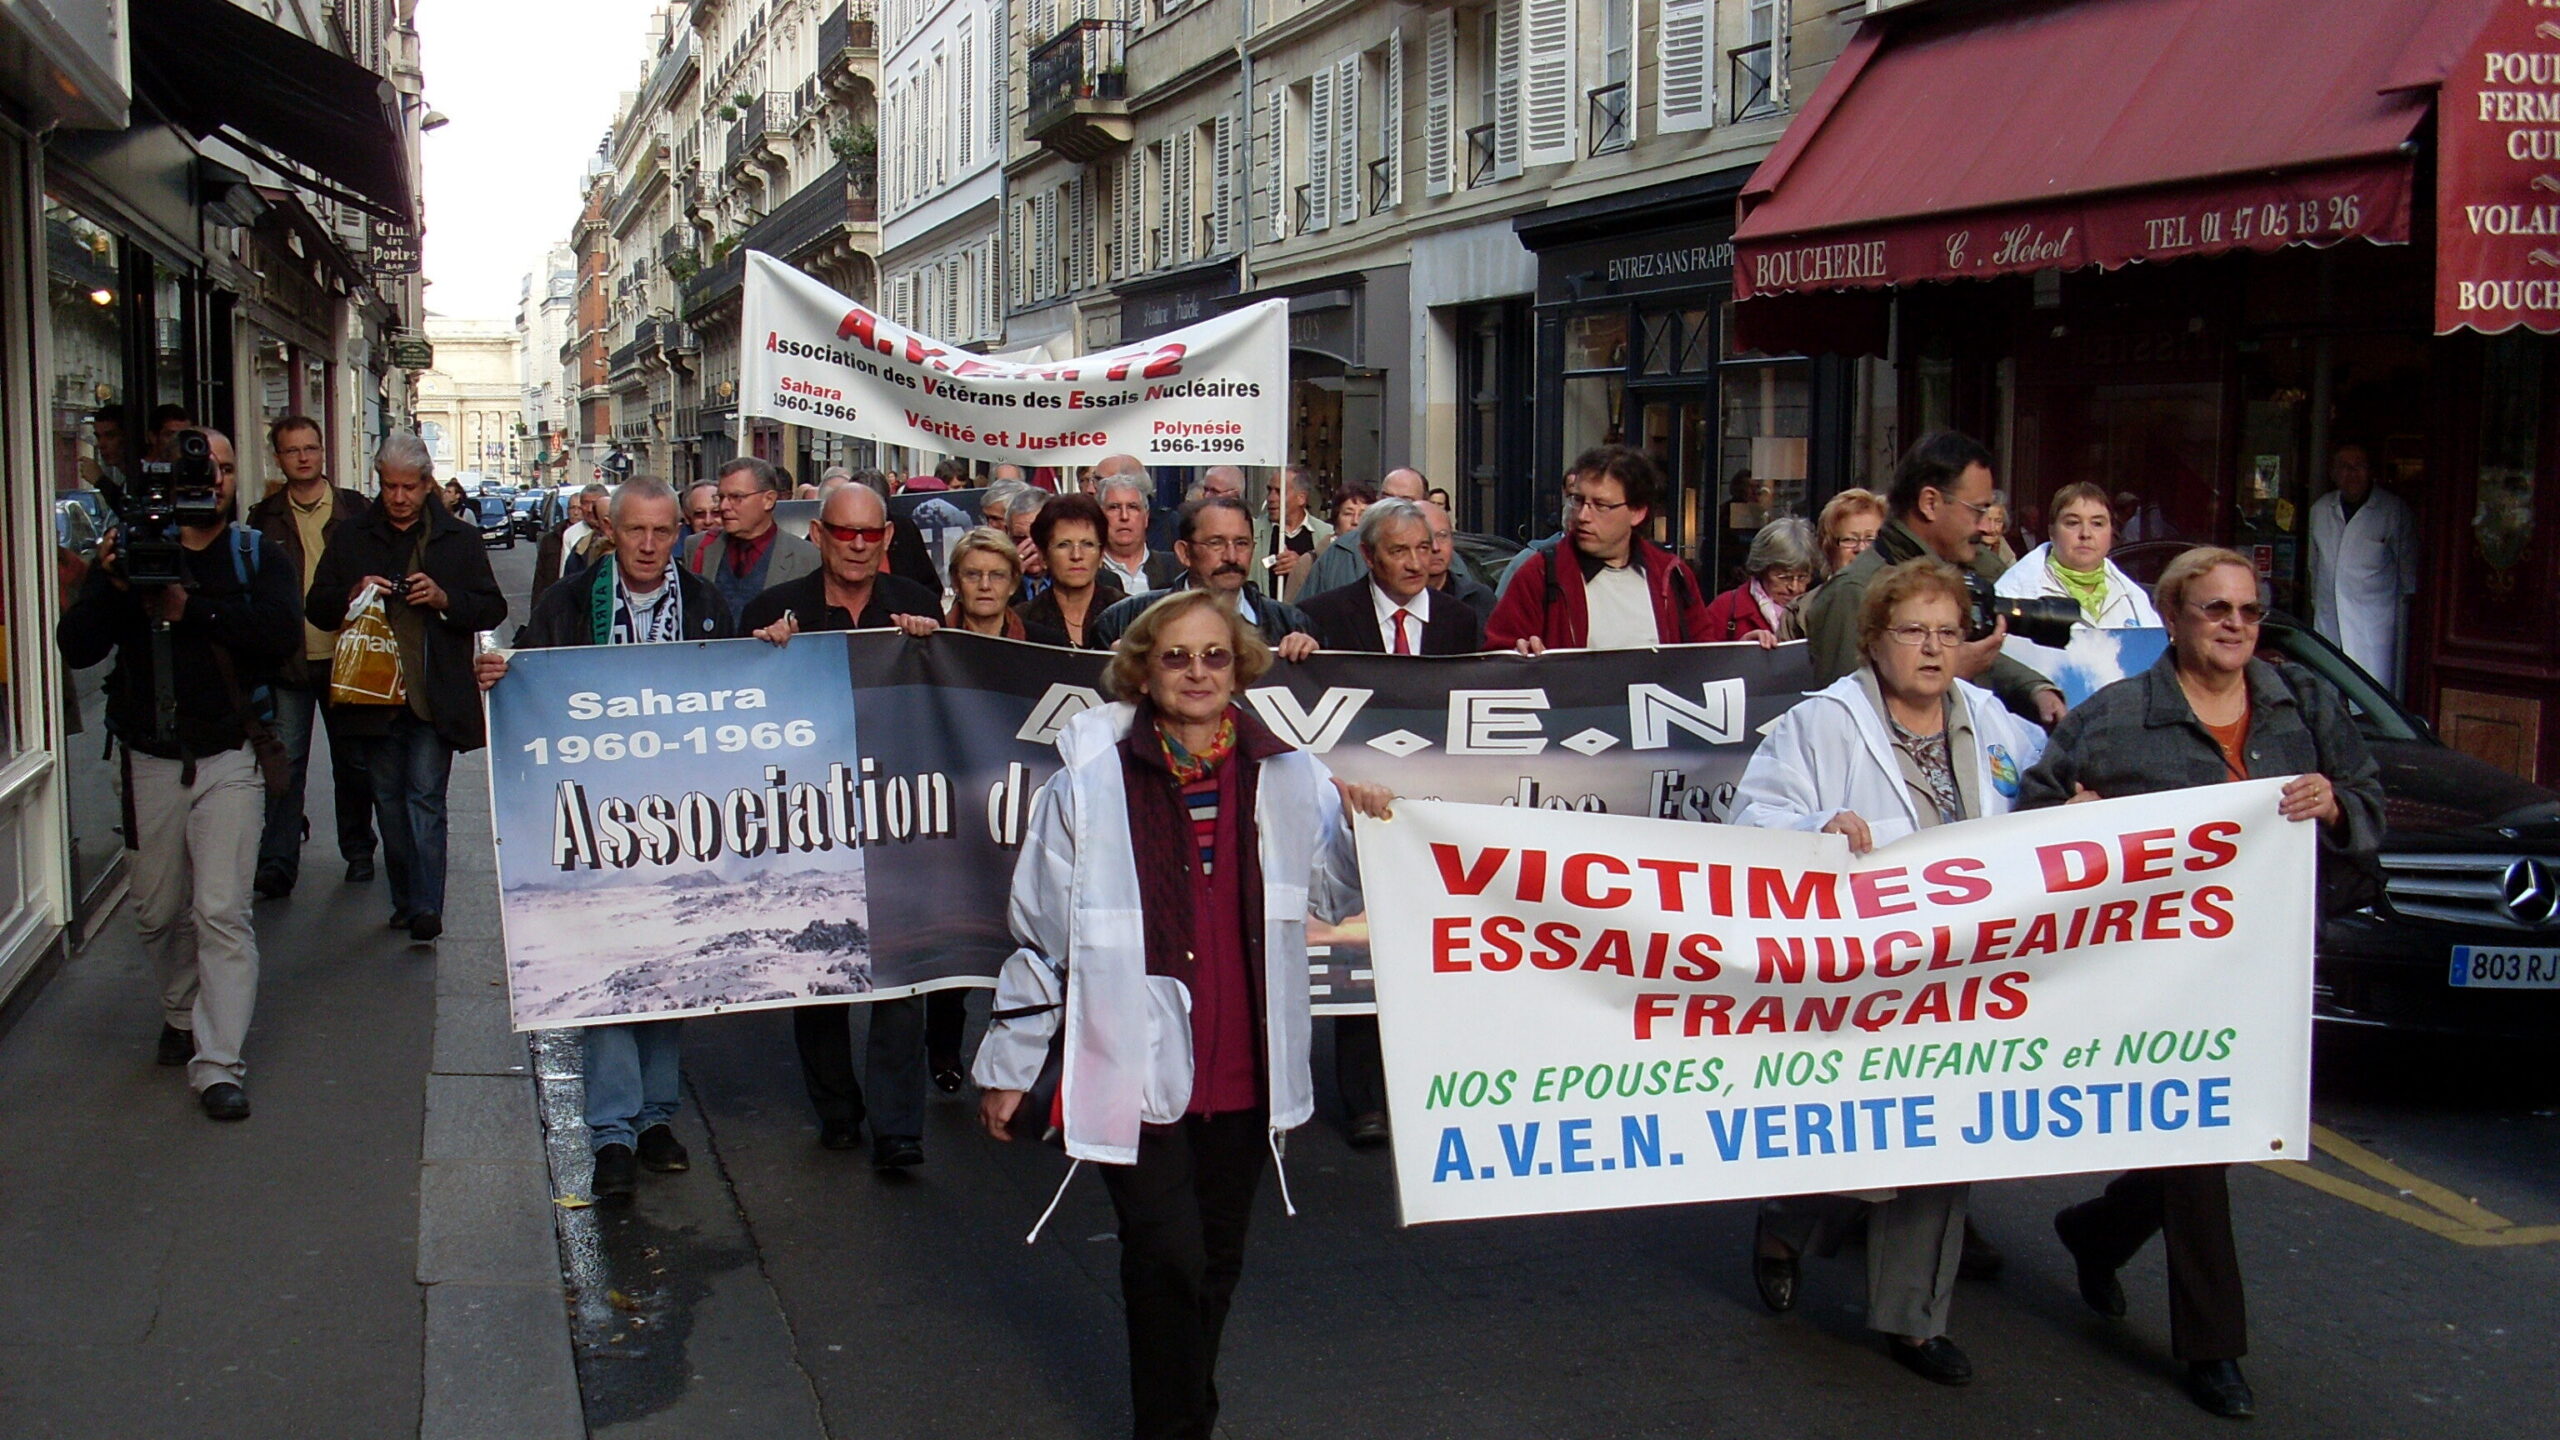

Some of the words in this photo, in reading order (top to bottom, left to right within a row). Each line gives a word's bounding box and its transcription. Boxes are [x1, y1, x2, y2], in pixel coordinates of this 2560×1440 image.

[386, 237, 404, 246] des
[2145, 216, 2192, 250] TEL
[2201, 211, 2221, 243] 01
[2231, 207, 2252, 239] 47
[2260, 203, 2290, 236] 05
[2298, 199, 2319, 233] 13
[2328, 194, 2360, 230] 26
[1756, 240, 1887, 287] BOUCHERIE
[1993, 223, 2074, 264] Hebert
[385, 263, 405, 271] BAR
[1609, 254, 1654, 281] ENTREZ
[1656, 250, 1688, 275] SANS
[766, 331, 879, 376] Association
[882, 367, 917, 390] des
[922, 376, 1016, 409] Vétérans
[1023, 390, 1061, 409] des
[1068, 389, 1139, 410] Essais
[1144, 379, 1260, 402] Nucléaires
[781, 377, 842, 401] Sahara
[773, 392, 857, 421] 1960-1966
[904, 409, 976, 443] Vérité
[983, 431, 1009, 448] et
[1016, 431, 1108, 450] Justice
[1150, 438, 1245, 453] 1966-1996
[1153, 420, 1242, 437] Polynésie
[568, 687, 767, 721] Sahara
[524, 719, 817, 765] 1960-1966
[551, 757, 953, 872] Association
[1430, 843, 1992, 921] VICTIMES
[2035, 820, 2242, 895] DES
[1433, 916, 1722, 983] ESSAIS
[1756, 885, 2234, 985] NUCLEAIRES
[2472, 953, 2521, 980] 803
[1634, 972, 2029, 1041] FRANÇAIS
[1426, 1071, 1516, 1110] NOS
[1533, 1057, 1734, 1100] EPOUSES,
[1754, 1050, 1843, 1088] NOS
[1859, 1038, 2048, 1082] ENFANTS
[2063, 1038, 2101, 1067] et
[2116, 1028, 2236, 1064] NOUS
[1433, 1110, 1683, 1183] A.V.E.N.
[1706, 1095, 1936, 1162] VERITE
[1961, 1077, 2231, 1143] JUSTICE
